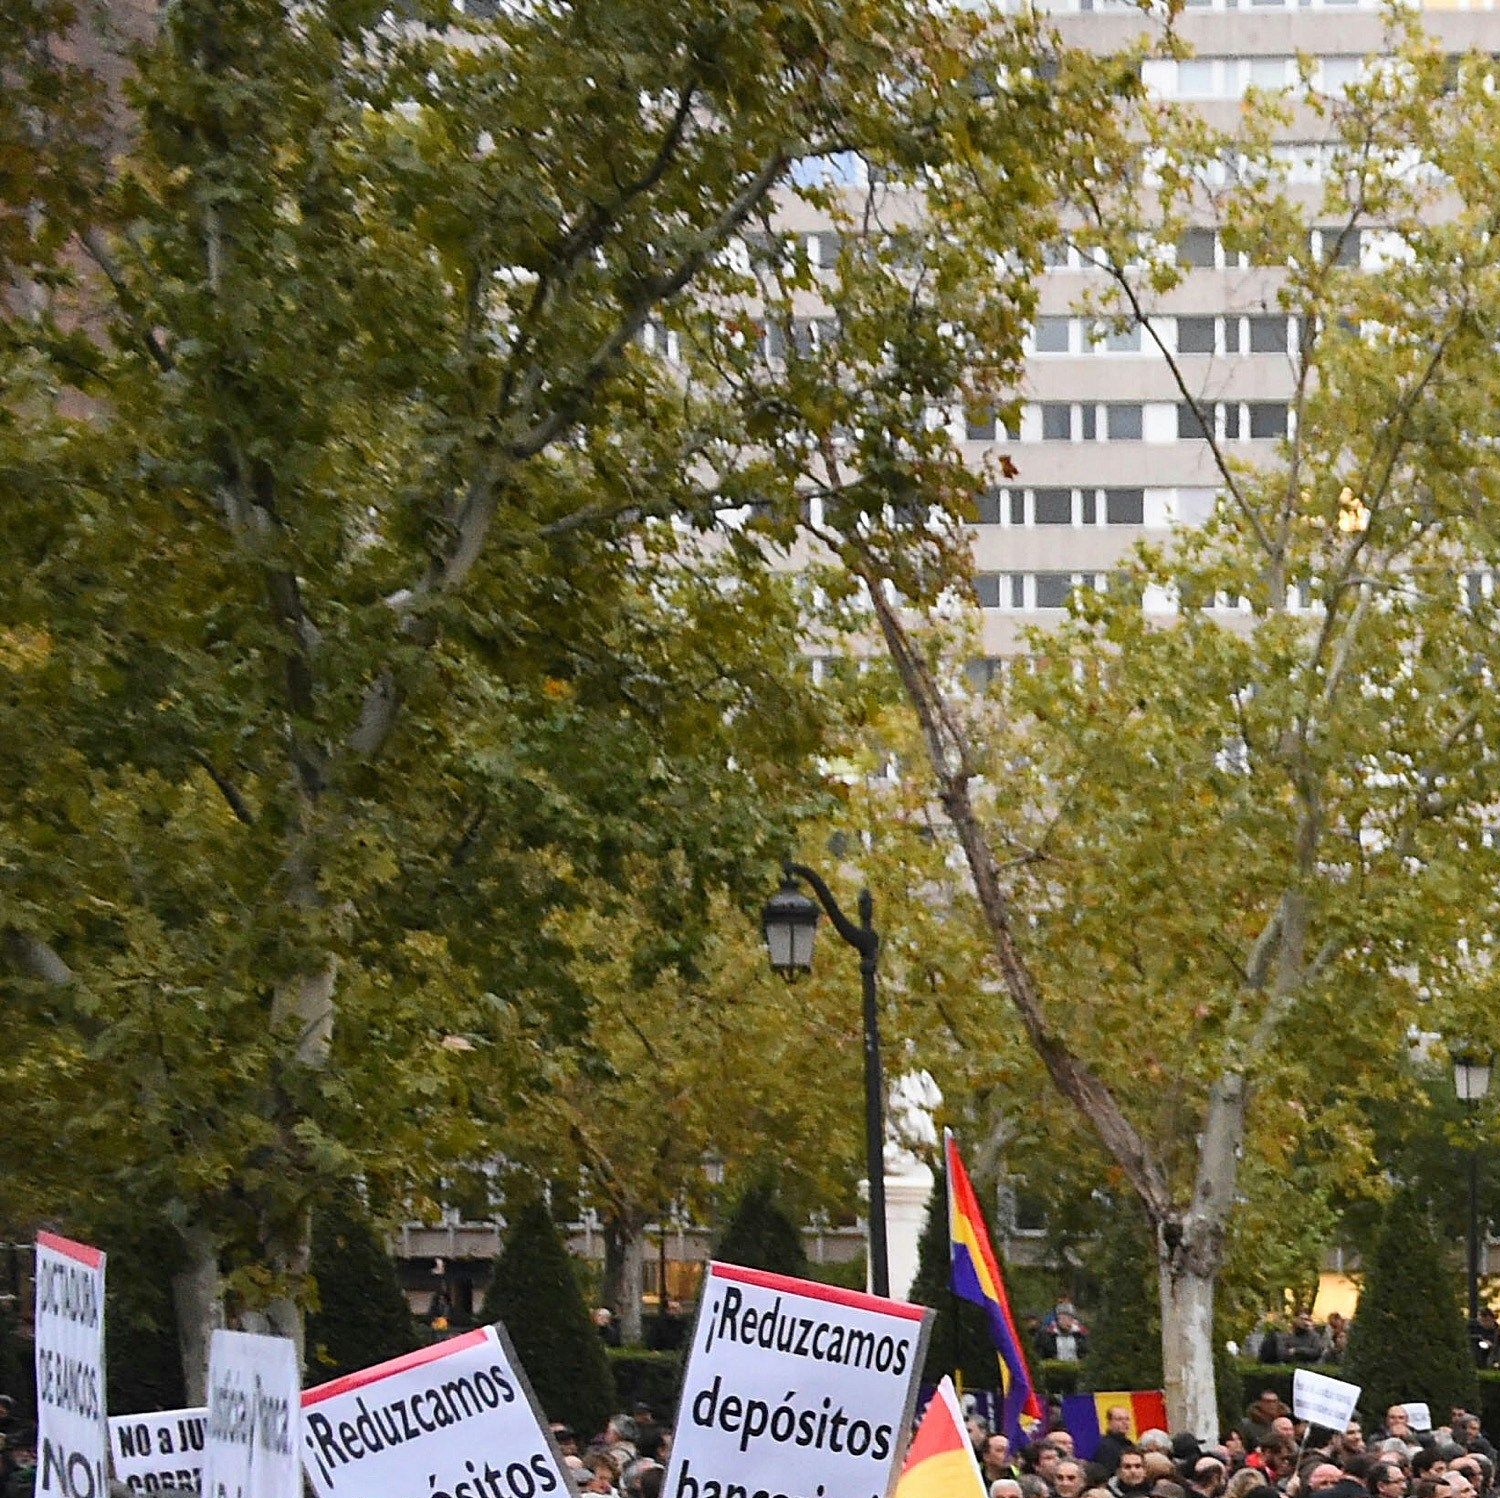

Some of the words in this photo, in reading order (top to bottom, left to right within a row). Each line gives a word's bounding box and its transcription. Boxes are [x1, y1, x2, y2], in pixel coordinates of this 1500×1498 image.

[705, 1286, 910, 1376] ¡Reduzcamos
[118, 1423, 152, 1458] NO
[157, 1427, 174, 1455] a
[305, 1365, 516, 1489] ¡Reduzcamos
[692, 1375, 893, 1460] depósitos
